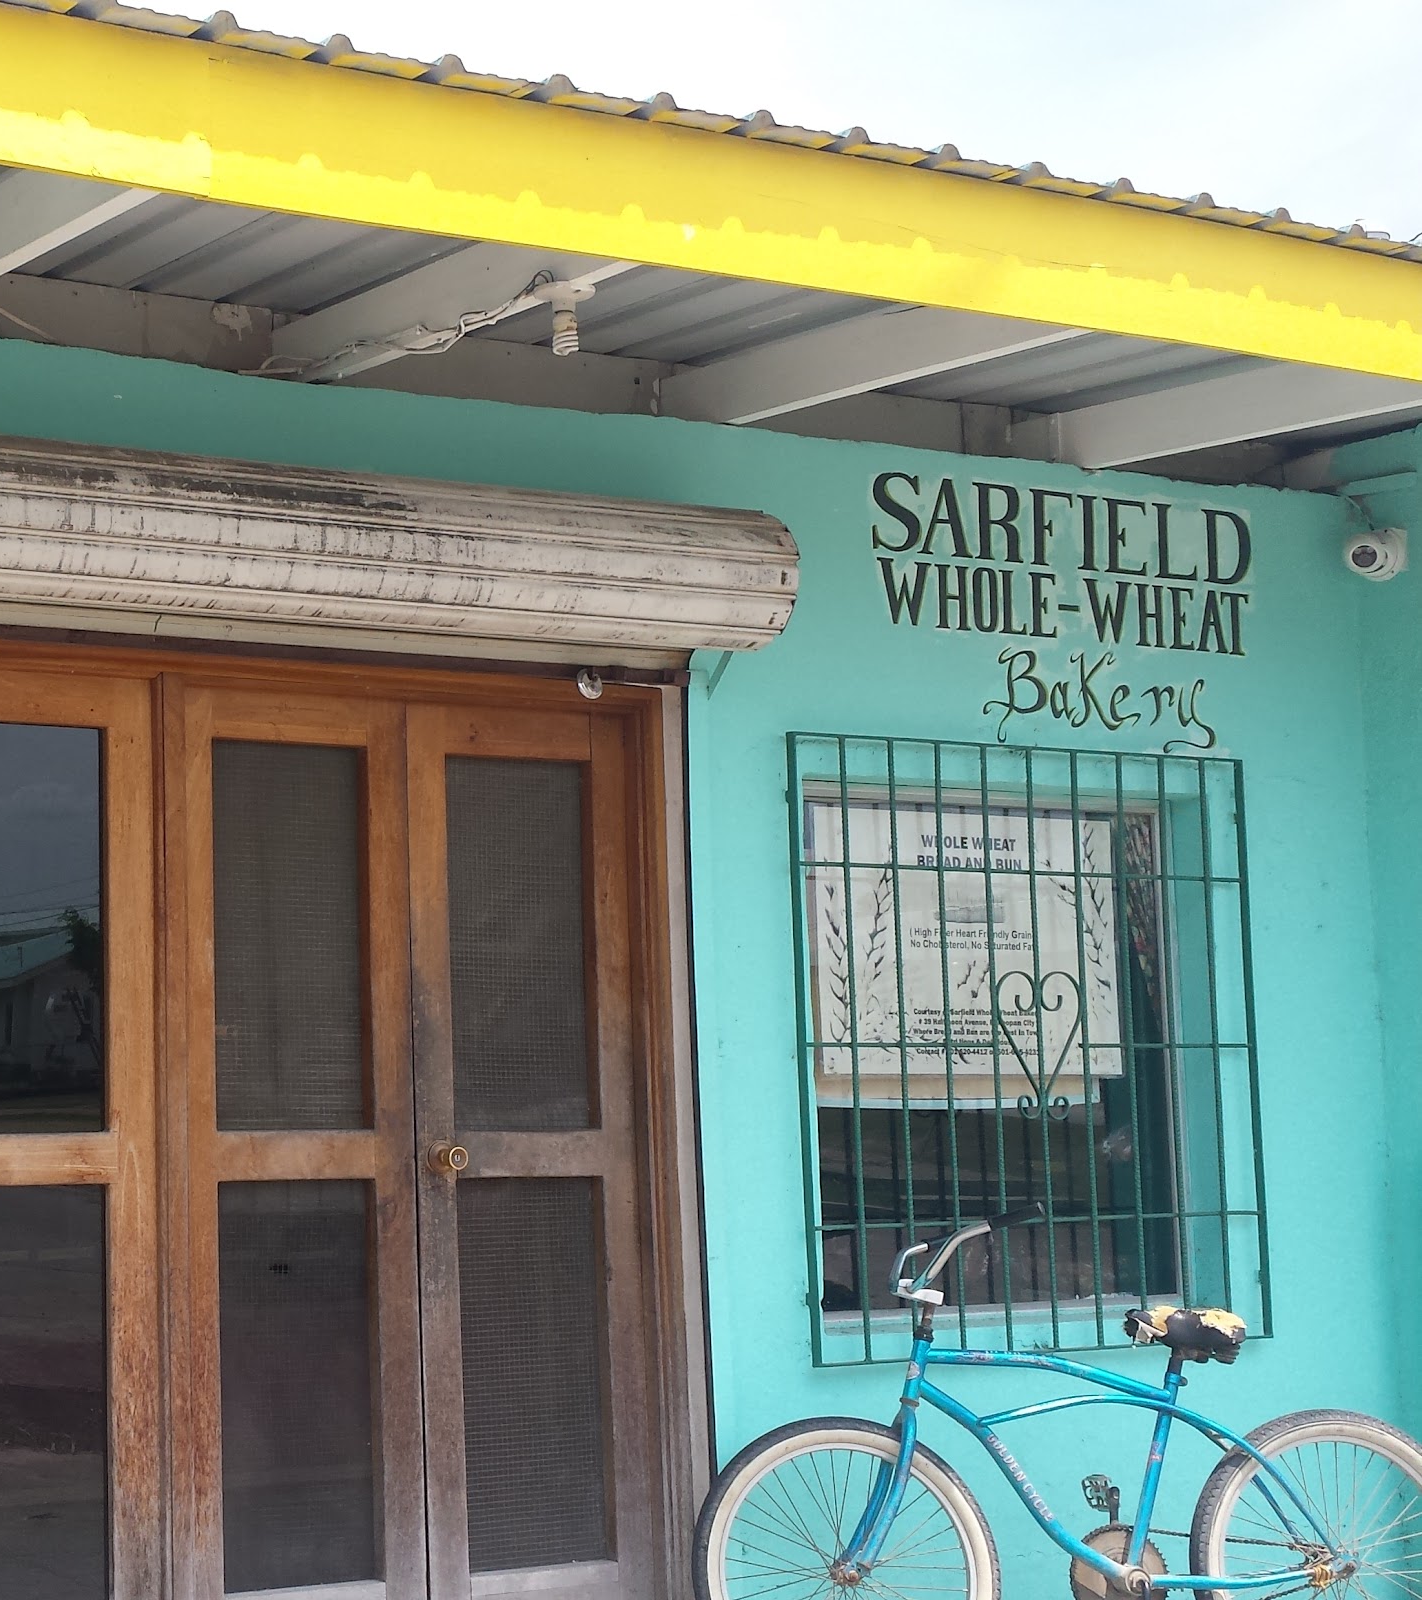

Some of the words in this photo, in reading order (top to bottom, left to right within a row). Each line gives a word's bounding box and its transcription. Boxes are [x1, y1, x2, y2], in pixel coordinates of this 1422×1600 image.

[872, 471, 1252, 585] SARFIELD
[876, 556, 1249, 656] WHOLE-WHEAT
[917, 855, 961, 868] BRAD
[965, 857, 989, 869] AN
[996, 858, 1022, 870] BUN
[910, 940, 921, 948] No
[923, 940, 970, 950] Cholsterol,
[971, 941, 982, 949] No
[984, 942, 1021, 950] Sturated
[914, 928, 932, 938] High
[934, 929, 954, 937] Fer
[956, 929, 976, 938] Heart
[978, 930, 1009, 940] Frndly
[1011, 931, 1034, 939] Grain
[986, 1433, 1026, 1482] GOLDEN
